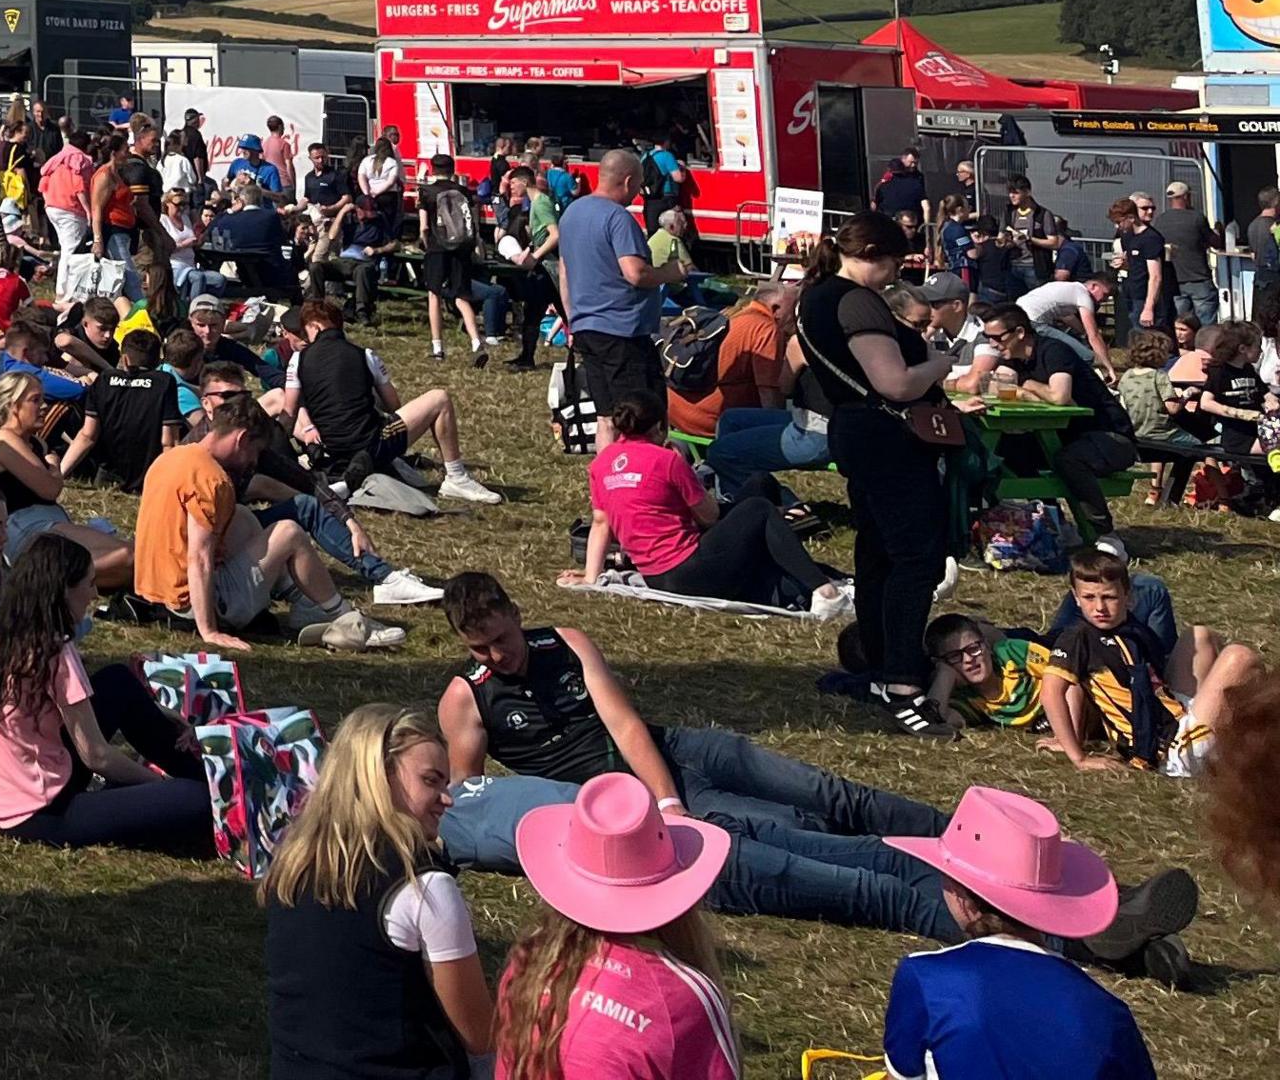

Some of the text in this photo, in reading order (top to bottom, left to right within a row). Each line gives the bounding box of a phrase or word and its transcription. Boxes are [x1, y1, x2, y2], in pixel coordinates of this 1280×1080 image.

[385, 4, 438, 17] BURGERS
[447, 3, 480, 17] FRIES
[610, 0, 660, 14] WRAPS
[45, 16, 125, 31] STONE BAKED PIZZA
[424, 66, 460, 77] BURGERS
[493, 67, 523, 77] WRAPS
[529, 67, 545, 77] TEA
[552, 67, 584, 78] COFFEE
[1146, 121, 1187, 131] Chicken
[1238, 120, 1280, 132] GOUR
[581, 990, 653, 1033] FAMILY
